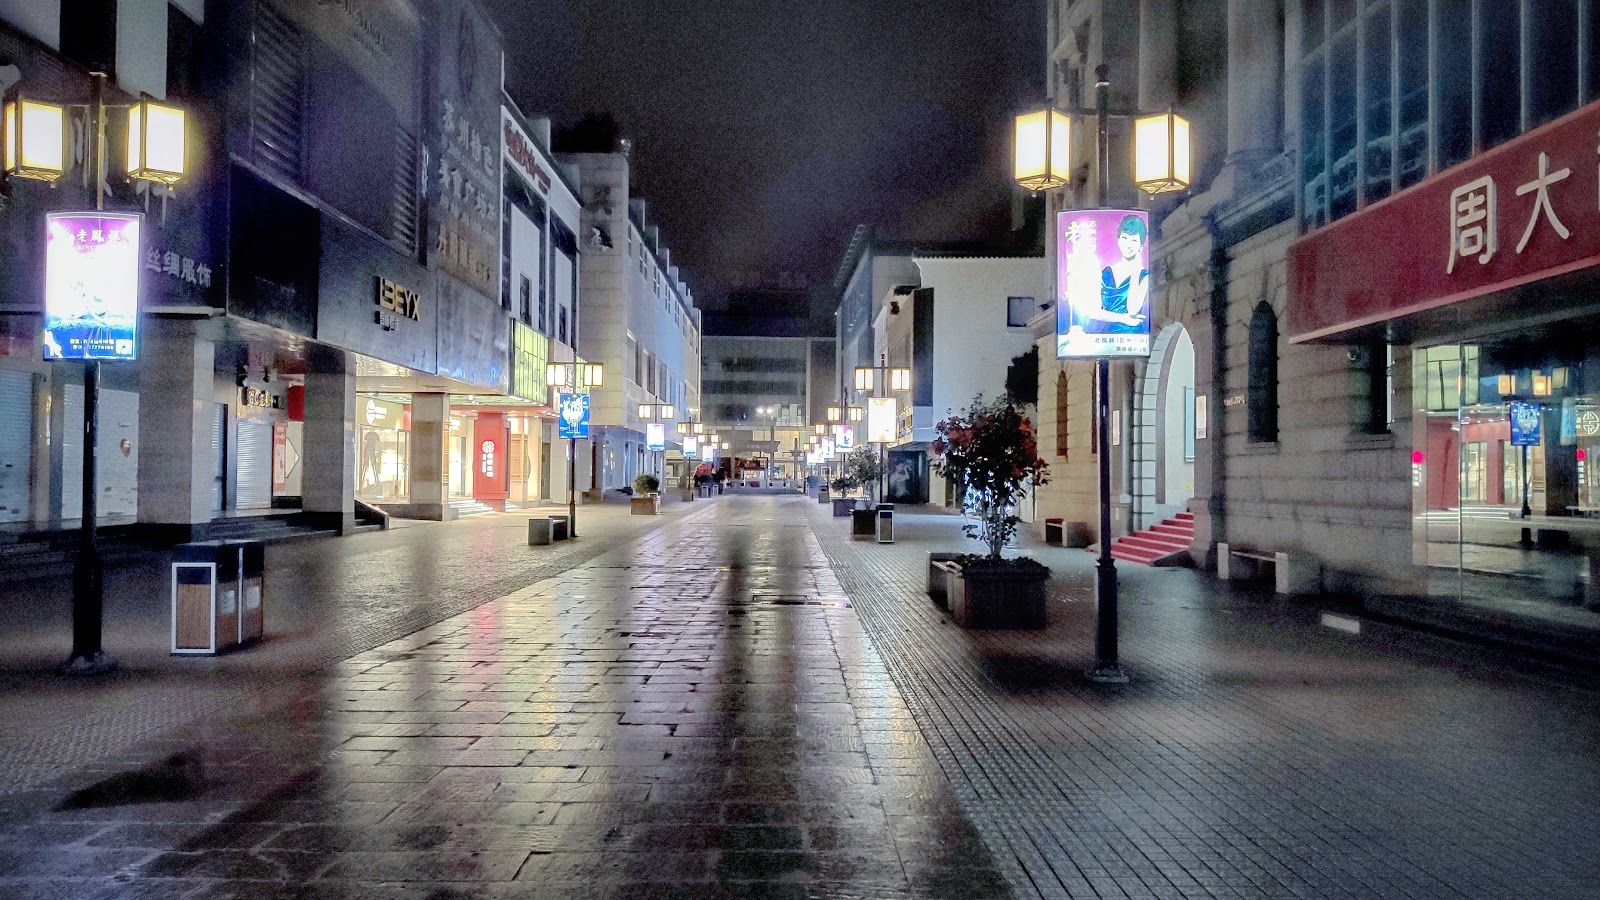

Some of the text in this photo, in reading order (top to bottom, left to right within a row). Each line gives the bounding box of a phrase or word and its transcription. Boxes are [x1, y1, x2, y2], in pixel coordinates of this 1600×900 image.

[1446, 134, 1600, 275] 周大
[144, 245, 212, 288] 丝绸服饰
